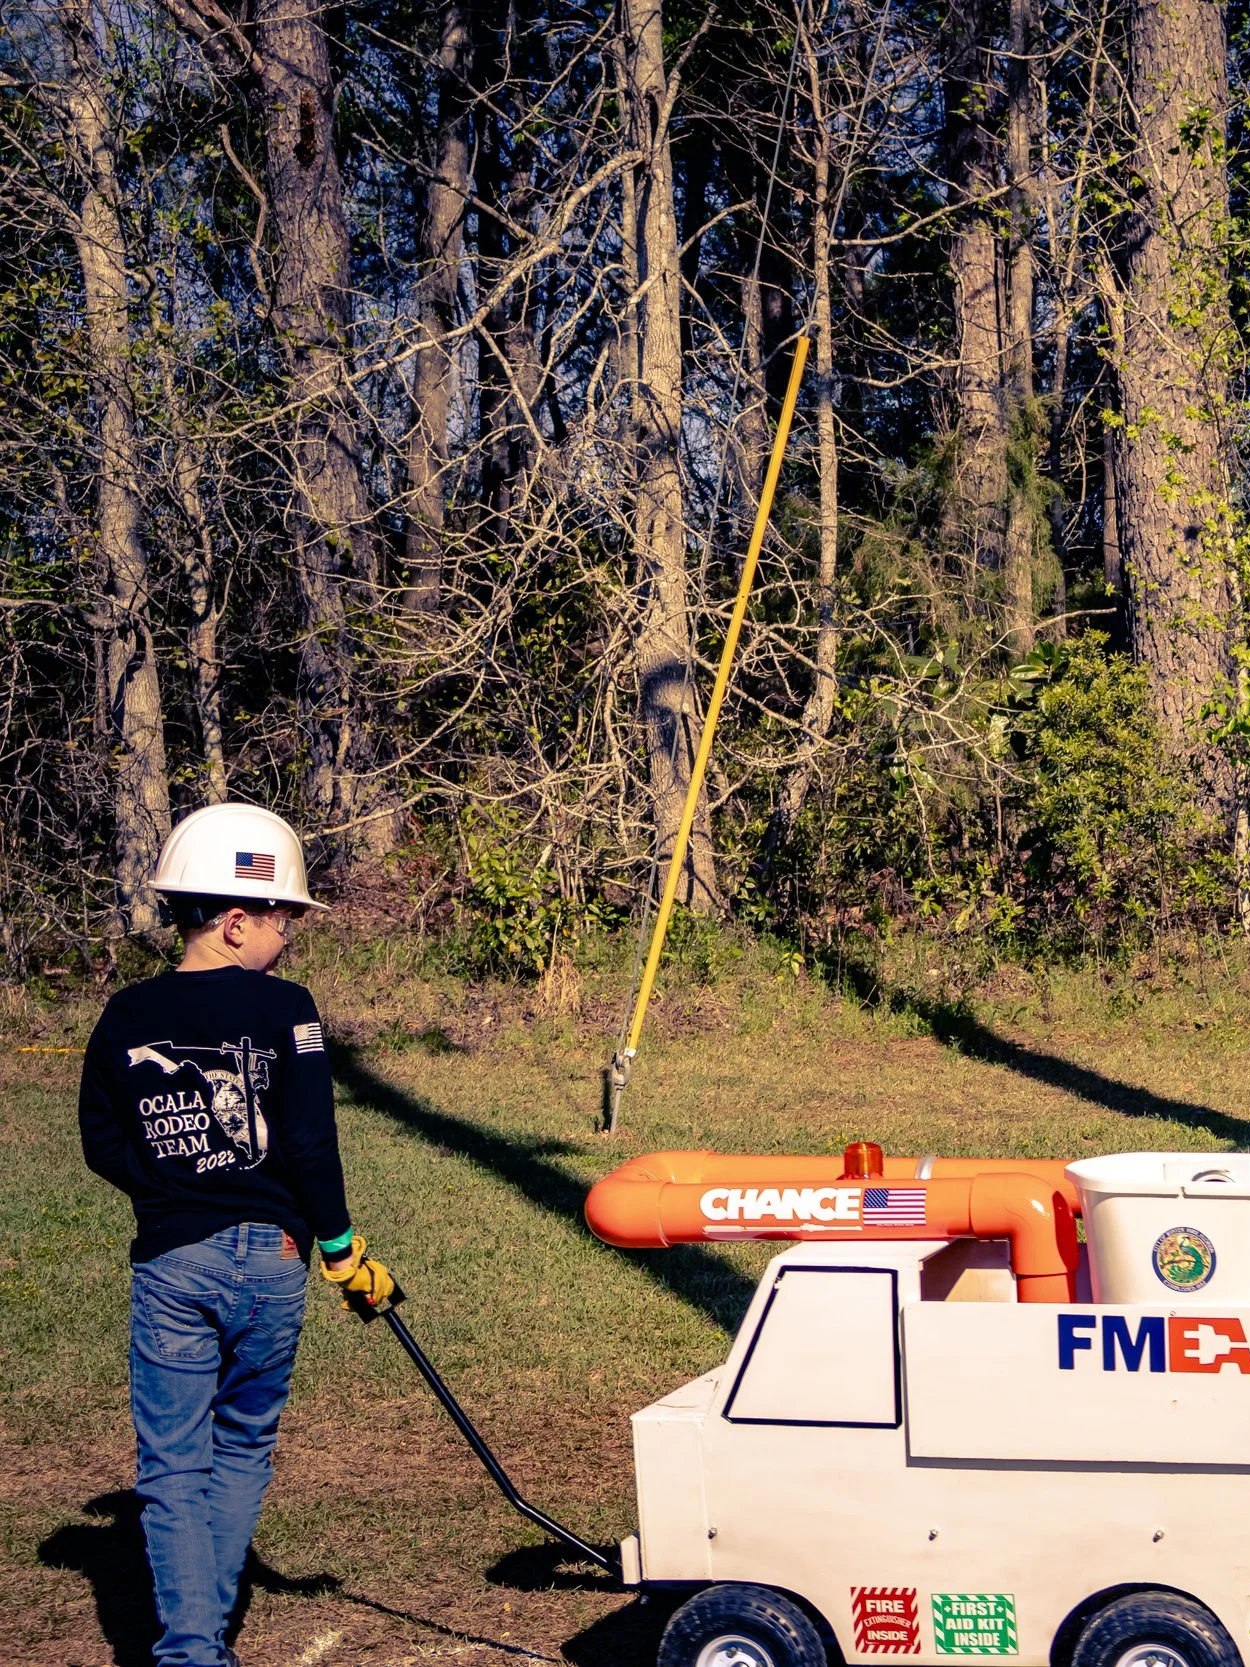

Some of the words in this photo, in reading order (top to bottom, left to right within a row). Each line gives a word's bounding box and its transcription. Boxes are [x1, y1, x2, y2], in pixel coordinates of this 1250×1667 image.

[139, 1090, 207, 1116] OCALA
[142, 1112, 211, 1140] RODEO
[151, 1133, 211, 1158] TEAM
[196, 1149, 236, 1174] 2022
[700, 1187, 862, 1221] CHANCE
[865, 1599, 906, 1614] FIRE
[951, 1602, 997, 1616] FIRST
[863, 1614, 912, 1629] EXTINGUISHER
[945, 1618, 974, 1630] AID
[977, 1618, 1005, 1630] KIT
[867, 1630, 909, 1641] INSIDE
[953, 1632, 1001, 1647] INSIDE
